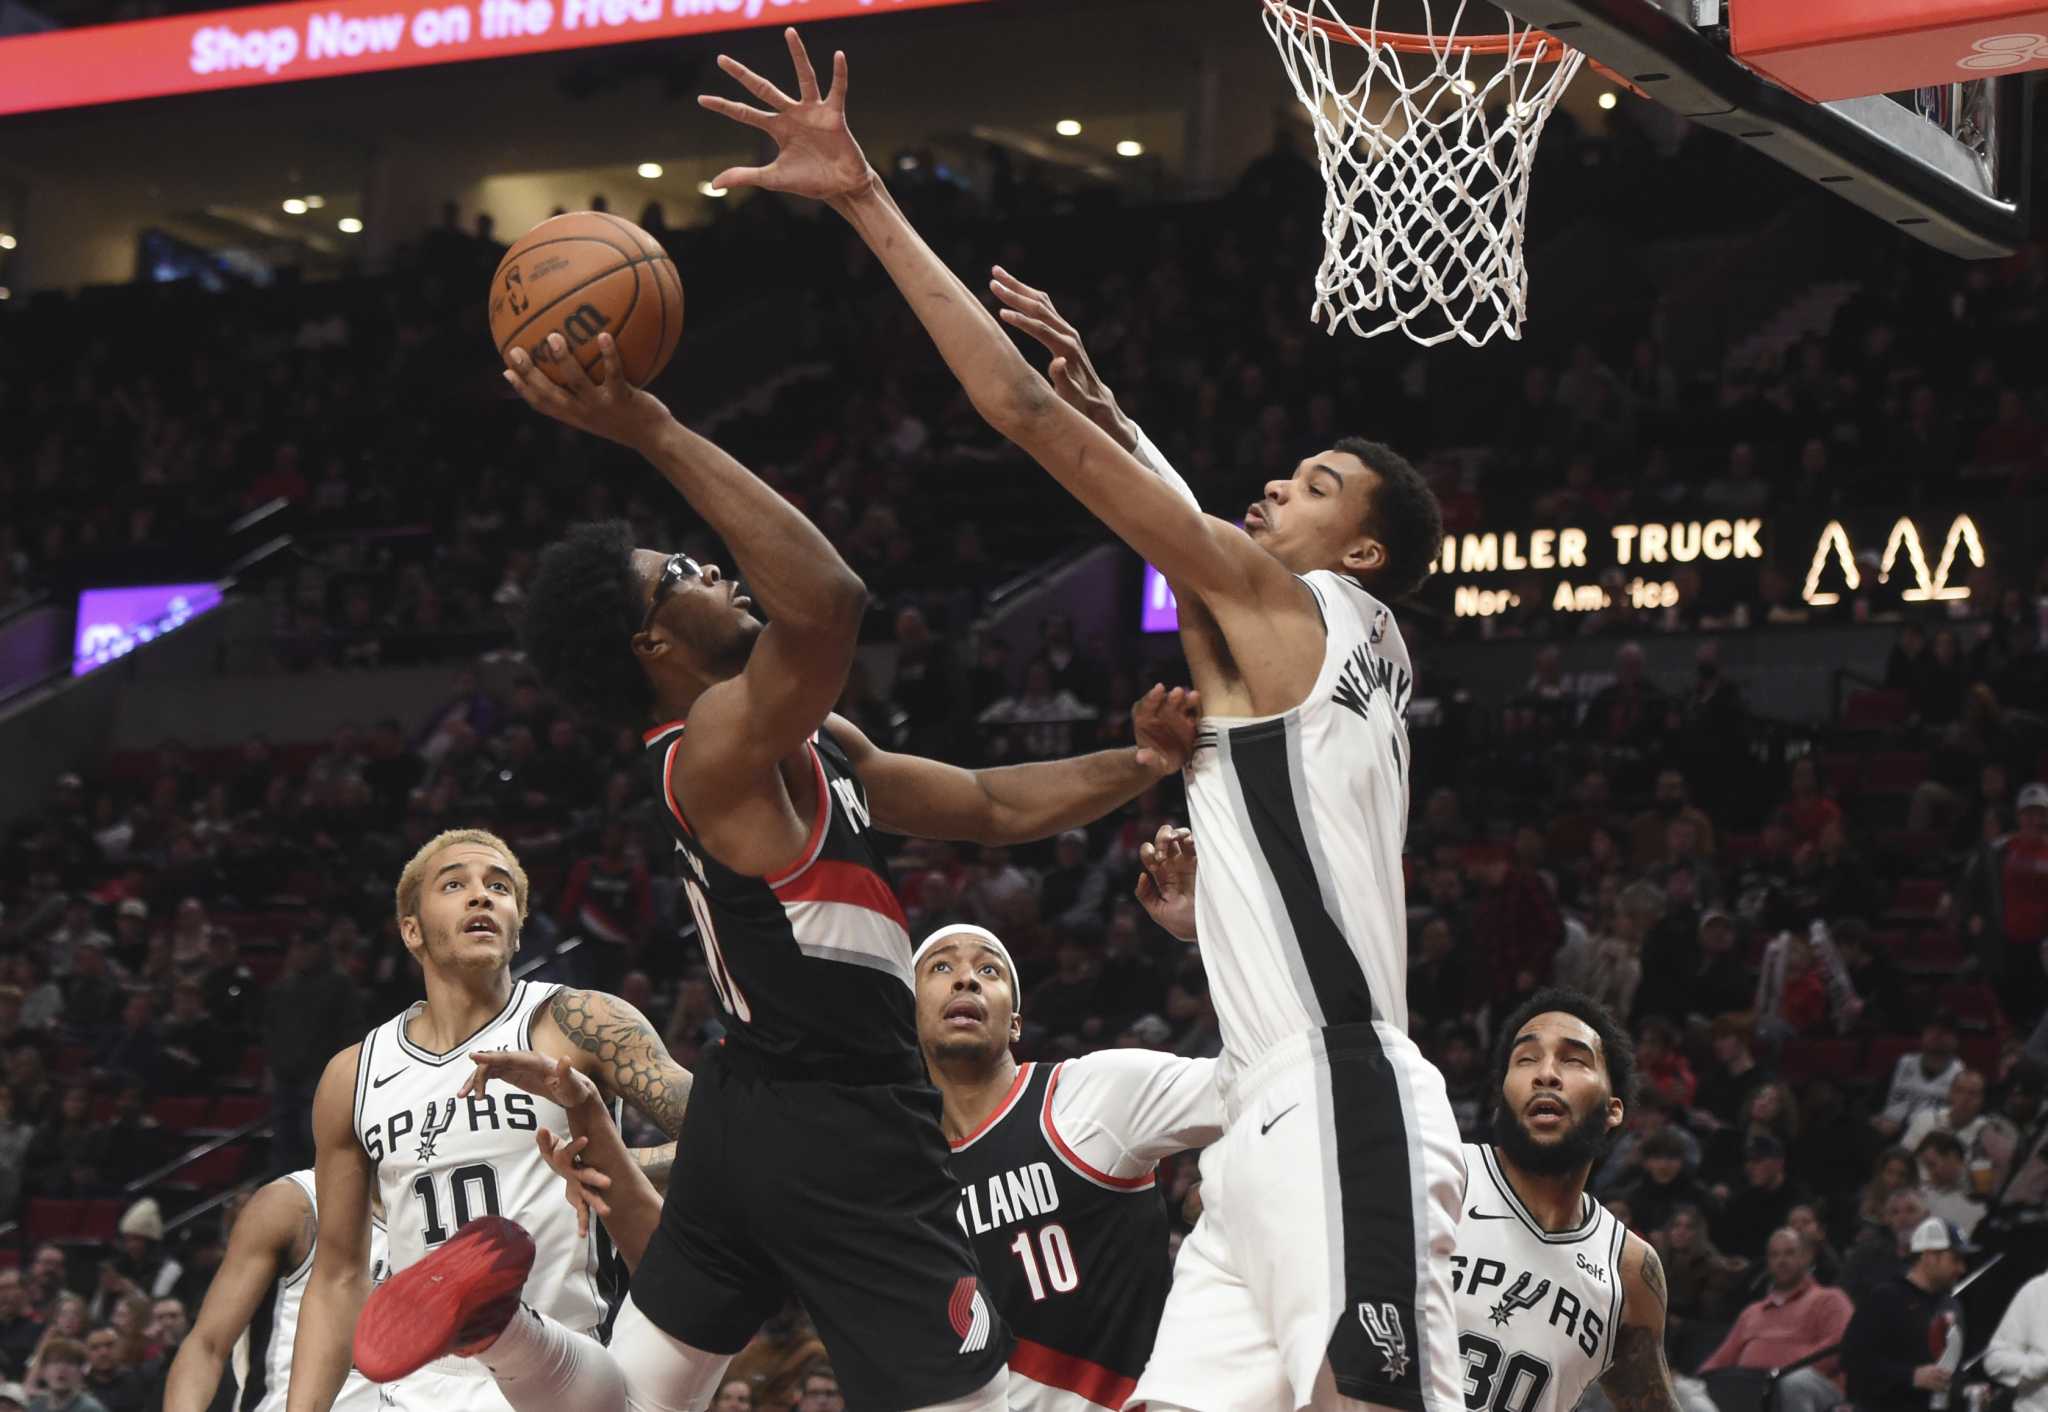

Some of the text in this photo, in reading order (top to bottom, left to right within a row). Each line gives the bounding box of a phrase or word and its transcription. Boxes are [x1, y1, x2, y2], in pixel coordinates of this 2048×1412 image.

[190, 26, 299, 75] Shop
[306, 11, 404, 60] Now
[411, 5, 470, 48] on
[1429, 518, 1763, 575] IMLER TRUCK
[1454, 584, 1521, 617] Nor
[364, 1093, 538, 1164] SPURS
[412, 1161, 504, 1249] 10
[1011, 1224, 1080, 1301] 10
[1576, 1252, 1607, 1284] Self.
[1457, 1329, 1554, 1412] 30
